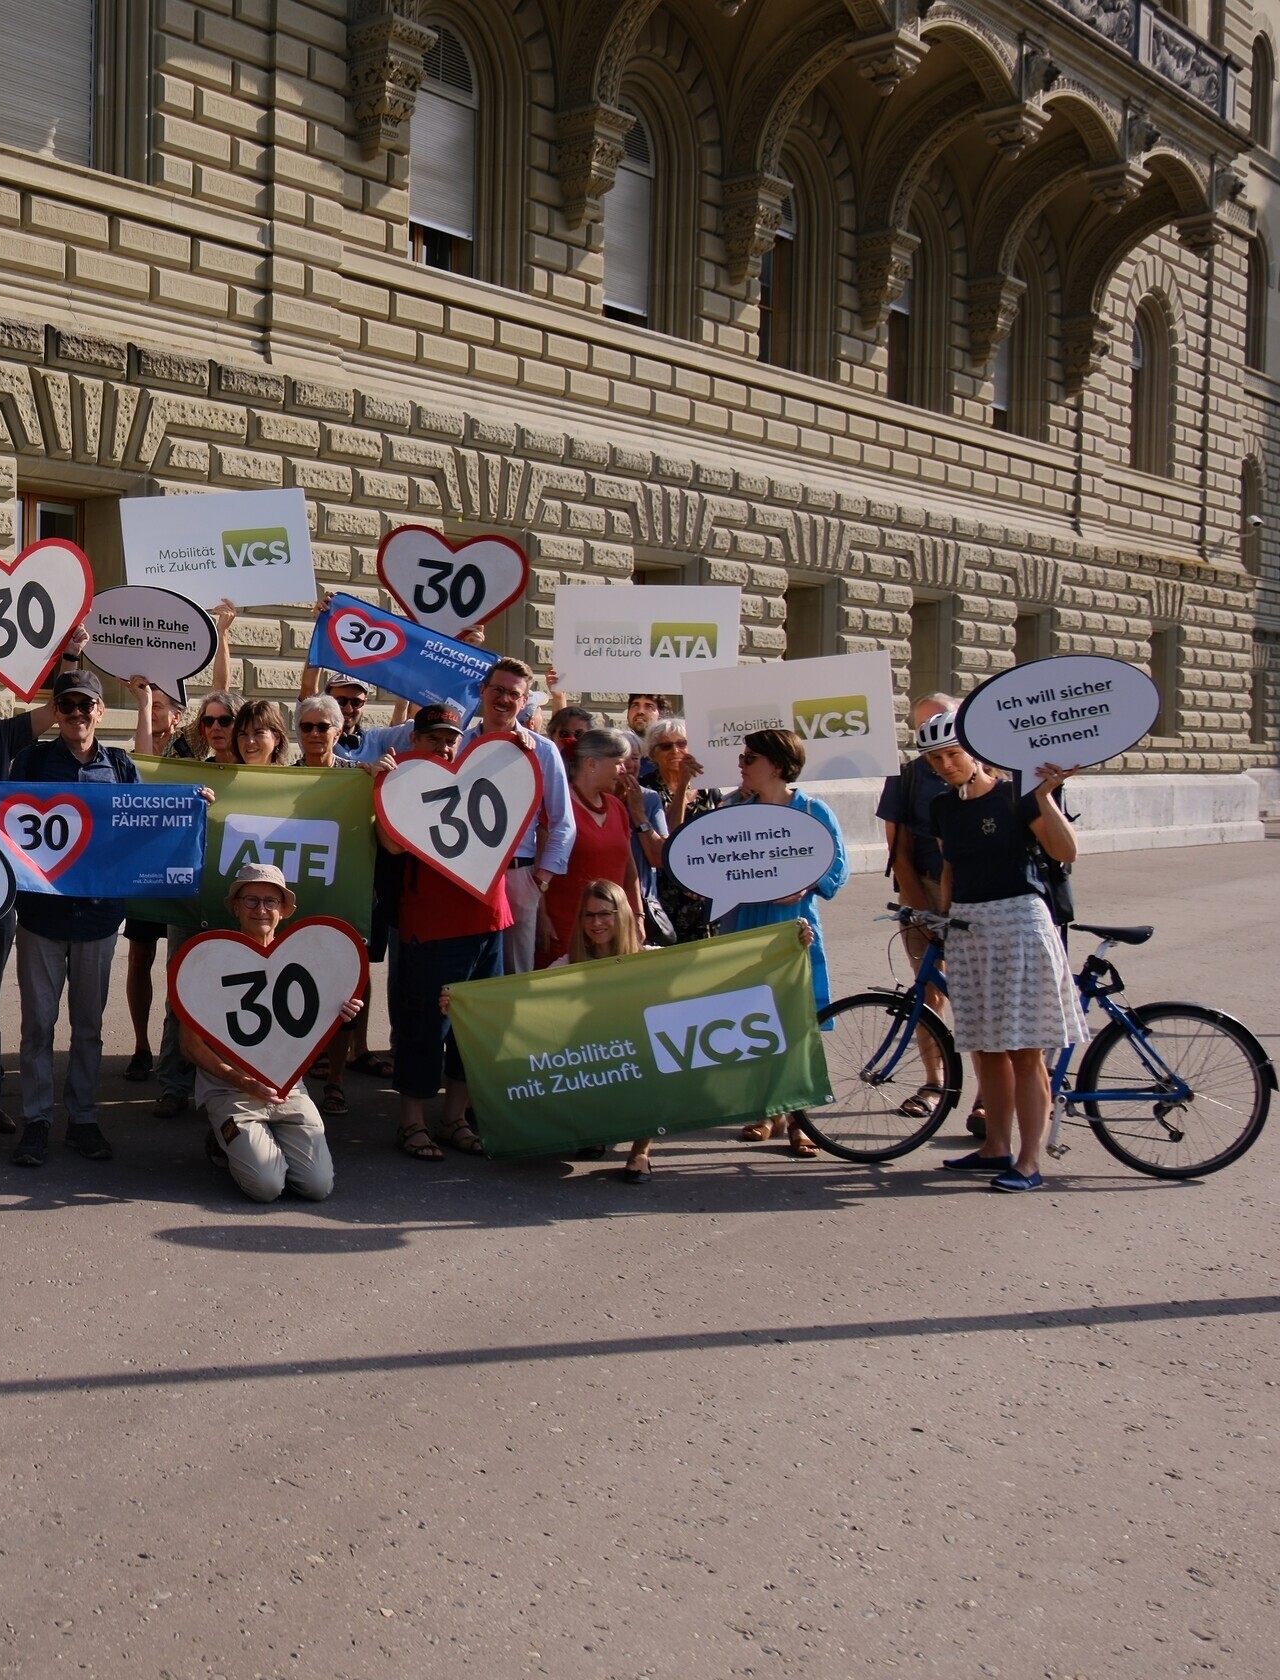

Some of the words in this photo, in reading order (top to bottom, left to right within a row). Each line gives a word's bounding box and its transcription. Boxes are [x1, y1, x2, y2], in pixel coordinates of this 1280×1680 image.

[159, 546, 215, 560] Mobilität
[225, 541, 288, 567] VCS
[145, 563, 166, 575] mit
[168, 559, 217, 573] Zukunft
[414, 558, 486, 618] 30
[98, 614, 116, 626] Ich
[119, 616, 140, 628] will
[143, 618, 154, 629] in
[157, 619, 189, 632] Ruhe
[92, 632, 143, 647] schlafen
[146, 637, 196, 651] können!
[341, 621, 387, 652] 30
[576, 635, 590, 645] La
[594, 635, 642, 646] mobilità
[653, 635, 714, 659] ATA
[420, 649, 459, 669] FÄHRT
[424, 640, 493, 672] RÜCKSICHT
[584, 647, 602, 657] del
[605, 647, 642, 658] futuro
[997, 696, 1022, 711] Ich
[1026, 688, 1056, 705] will
[1060, 680, 1112, 699] sicher
[723, 718, 784, 733] Mobilität
[795, 711, 866, 739] VCS
[1009, 714, 1047, 730] Velo
[1050, 703, 1110, 723] fahren
[707, 736, 730, 748] mit
[1028, 725, 1099, 749] können!
[111, 794, 194, 809] RÜCKSICHT
[111, 812, 158, 827] FÄHRT
[162, 815, 192, 827] MIT!
[421, 778, 508, 859] 30
[17, 814, 69, 851] 30
[701, 834, 723, 846] Ich
[726, 831, 751, 843] will
[755, 827, 791, 841] mich
[224, 839, 329, 885] ATE
[687, 855, 705, 865] im
[707, 849, 766, 864] Verkehr
[769, 846, 814, 858] sicher
[167, 873, 192, 884] VCS
[725, 866, 778, 881] fühlen!
[221, 962, 318, 1047] 30
[654, 1012, 780, 1070] VCS
[529, 1039, 637, 1072] Mobilität
[507, 1080, 546, 1100] mit
[550, 1062, 643, 1094] Zukunft
